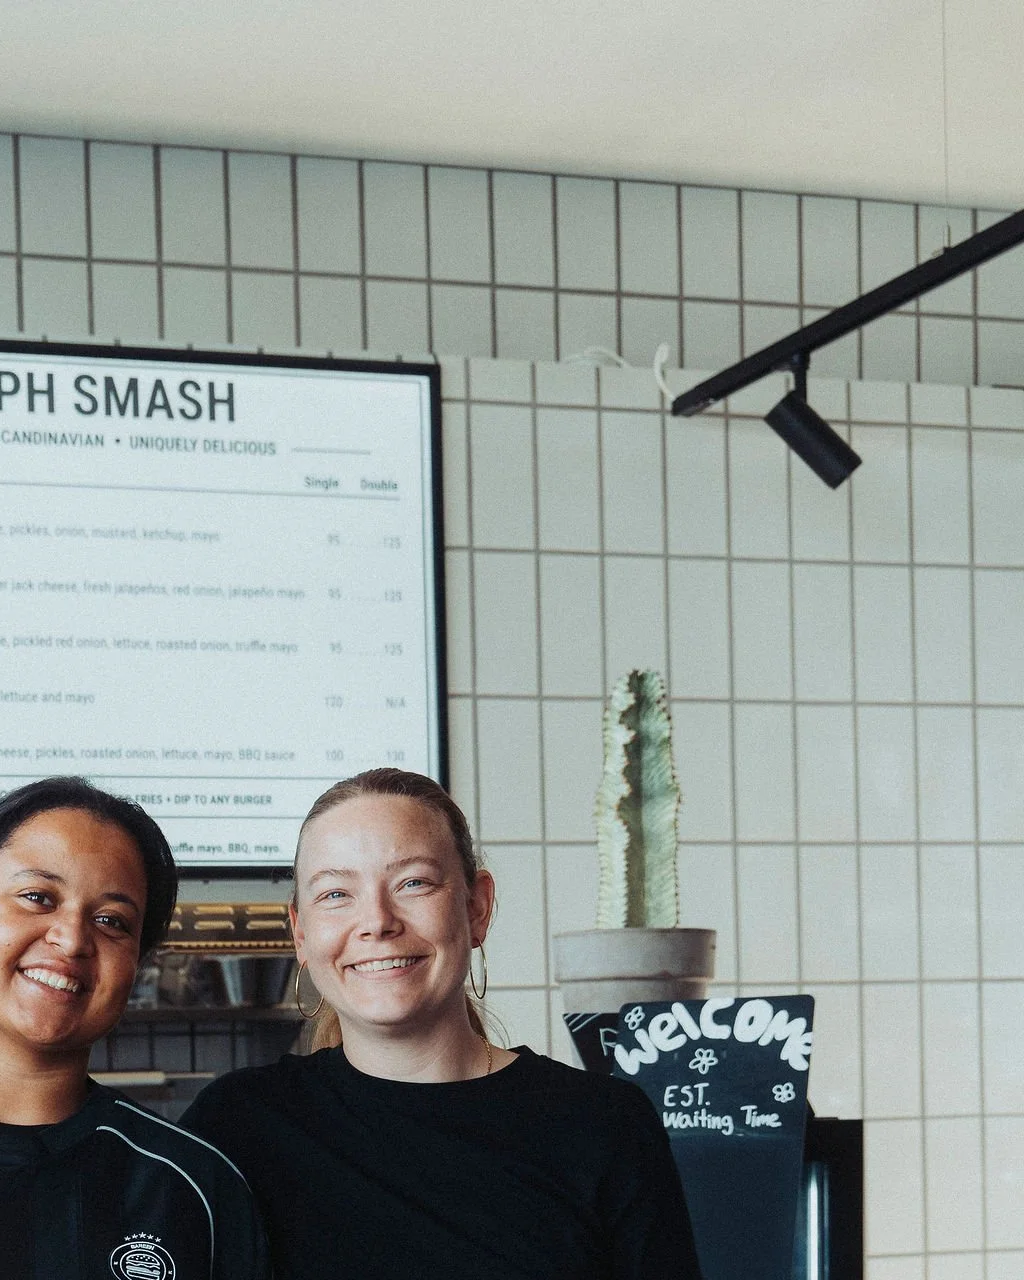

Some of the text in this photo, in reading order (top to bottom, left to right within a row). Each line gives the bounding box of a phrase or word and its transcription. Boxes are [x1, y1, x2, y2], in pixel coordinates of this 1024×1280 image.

[74, 374, 236, 423] SMASH
[129, 435, 197, 454] UNIQUELY
[203, 438, 277, 456] DELICIOUS
[304, 476, 399, 491] Single Double
[0, 689, 37, 701] lettuce
[41, 690, 62, 702] and
[64, 693, 94, 704] mayo
[136, 794, 162, 804] FRIES
[175, 794, 190, 804] DIP
[195, 795, 207, 805] TO
[211, 795, 230, 805] ANY
[233, 795, 272, 805] BURGER
[173, 842, 194, 853] uffle
[663, 1083, 711, 1107] EST.
[663, 1105, 782, 1136] Waiting Time
